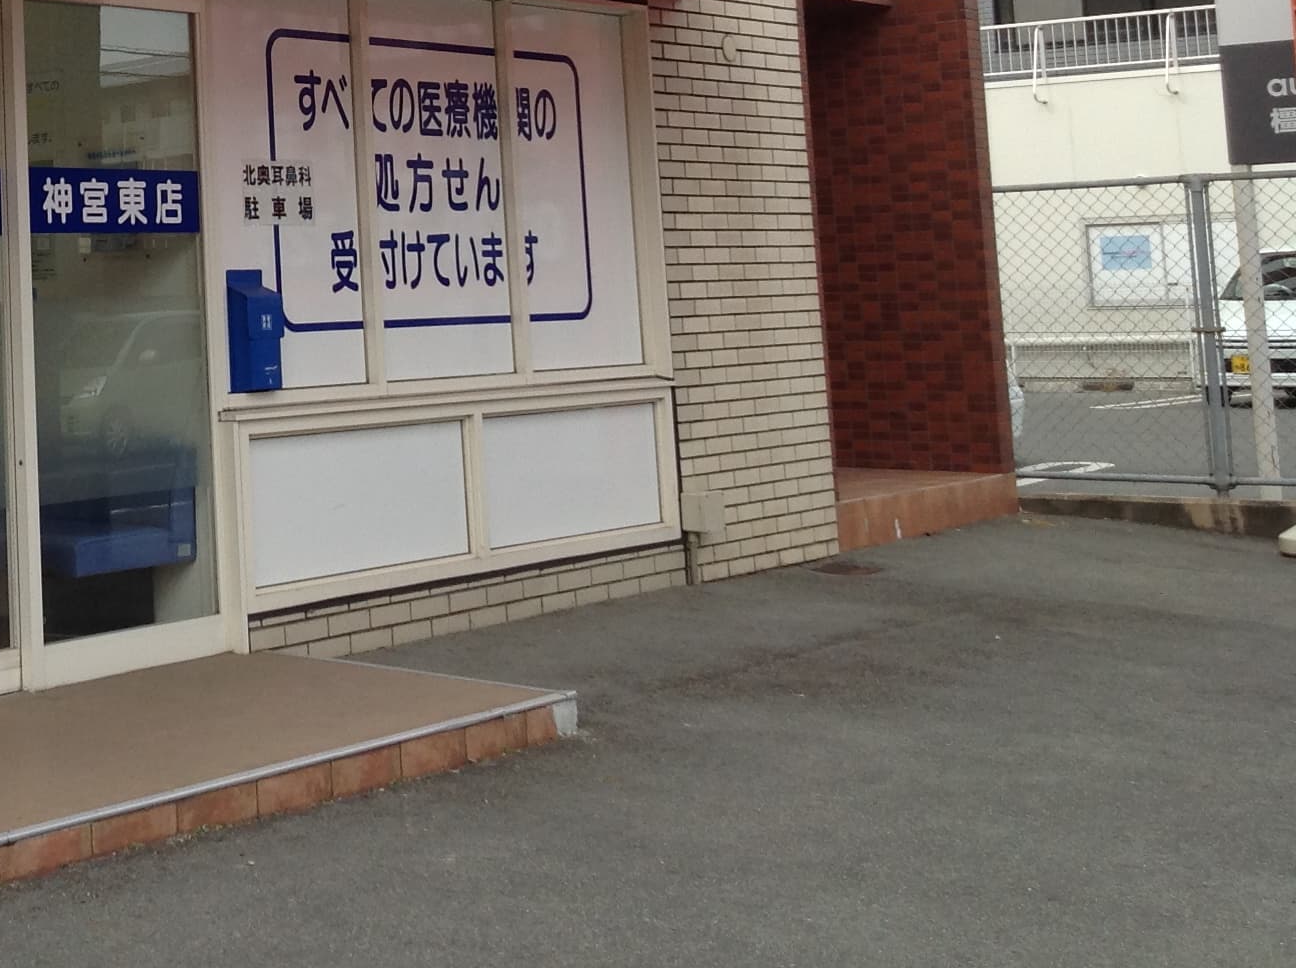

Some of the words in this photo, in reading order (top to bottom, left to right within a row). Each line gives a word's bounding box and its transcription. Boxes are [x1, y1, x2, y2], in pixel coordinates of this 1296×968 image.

[243, 164, 311, 187] 北奥耳鼻科
[374, 152, 502, 214] 処方せん
[42, 176, 184, 226] 神宮東店
[244, 196, 313, 220] 駐車場
